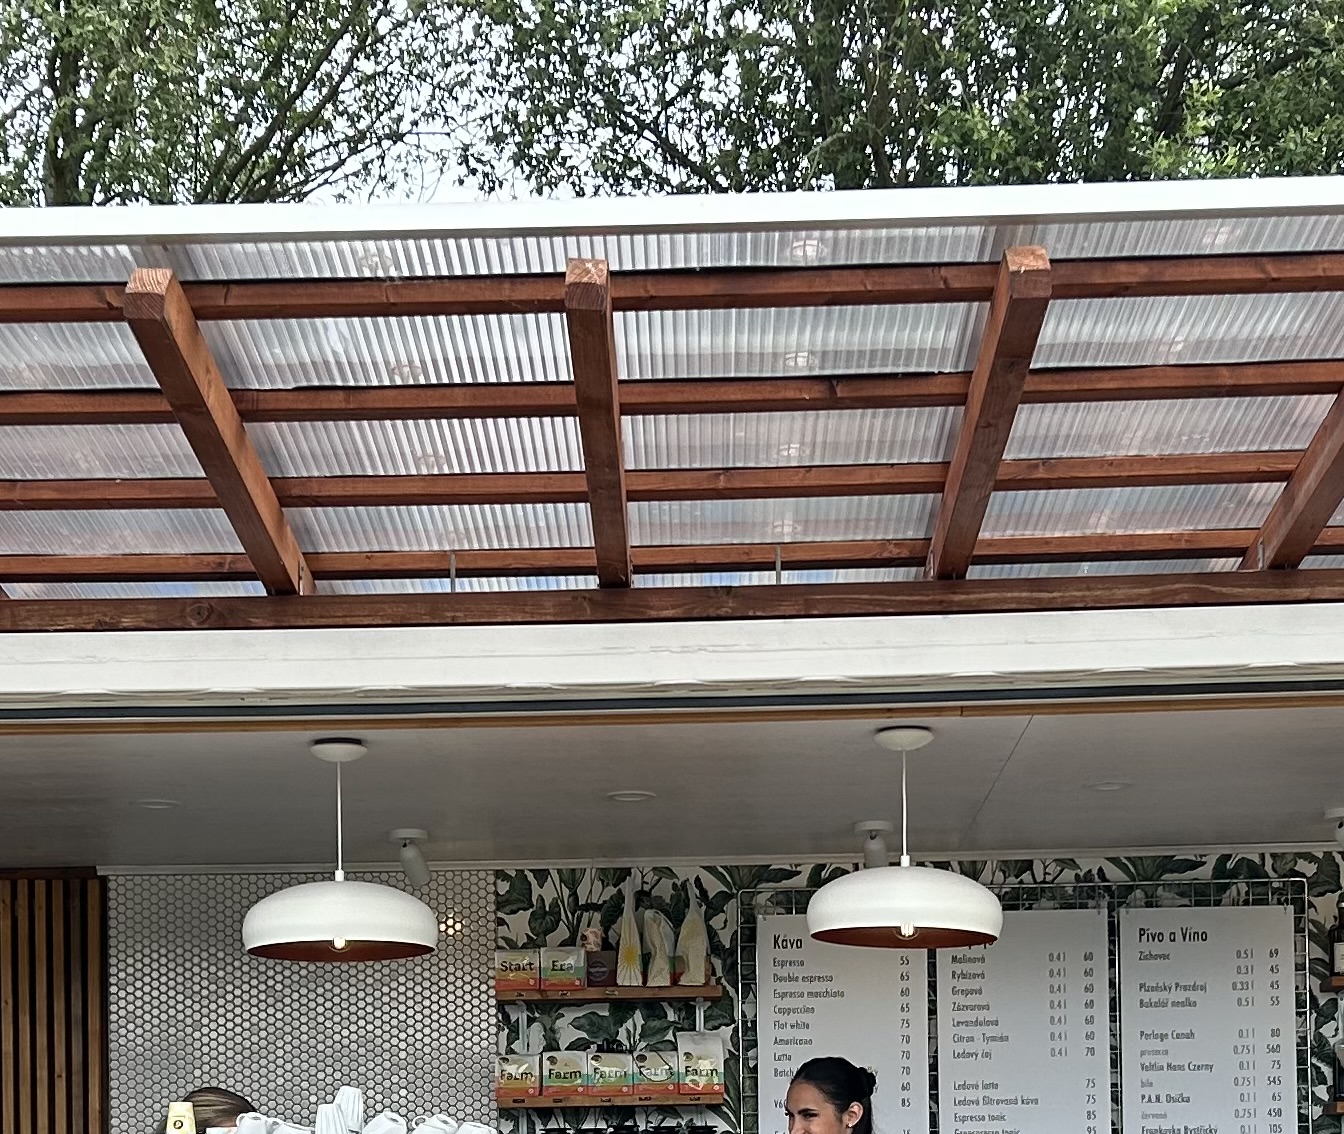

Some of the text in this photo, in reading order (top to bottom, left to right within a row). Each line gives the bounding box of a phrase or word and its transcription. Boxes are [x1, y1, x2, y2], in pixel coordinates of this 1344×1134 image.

[1169, 931, 1176, 942] a
[1181, 926, 1208, 942] Víno
[773, 934, 803, 950] Káva
[951, 954, 985, 964] Malinová
[1084, 952, 1093, 961] 60
[1269, 948, 1278, 958] 69
[500, 960, 535, 972] Start
[551, 960, 574, 972] Era
[773, 956, 910, 968] Espresso 55
[1084, 968, 1094, 977] 60
[1270, 964, 1279, 974] 45
[773, 971, 910, 984] Double espresso 65
[1084, 984, 1094, 993] 60
[1175, 981, 1207, 993] Prazdroj
[1270, 980, 1279, 990] 45
[774, 987, 910, 1000] Espresso macchiato 60
[1084, 1000, 1094, 1009] 60
[1171, 997, 1197, 1008] nealko
[1270, 996, 1280, 1006] 55
[774, 1003, 910, 1016] Cappuccino 65
[774, 1019, 910, 1030] Flat white 75
[1085, 1016, 1094, 1025] 60
[953, 1034, 974, 1043] Citron
[1085, 1032, 1095, 1040] 60
[1271, 1028, 1280, 1038] 80
[773, 1035, 910, 1046] Americano 70
[953, 1050, 978, 1061] Ledový
[1085, 1047, 1095, 1056] 70
[1266, 1044, 1280, 1054] 560
[774, 1050, 910, 1061] Latte 70
[1271, 1060, 1281, 1069] 75
[500, 1069, 534, 1081] Farm
[548, 1068, 582, 1080] Farm
[684, 1065, 719, 1078] Farm
[774, 1066, 910, 1078] Batch 70
[982, 1080, 998, 1090] latte
[1086, 1078, 1095, 1088] 75
[1267, 1076, 1281, 1085] 545
[901, 1082, 910, 1091] 60
[1086, 1095, 1096, 1104] 75
[1272, 1092, 1281, 1101] 65
[901, 1098, 911, 1107] 85
[954, 1110, 1096, 1124] Espresso tonic 85
[1267, 1108, 1282, 1117] 450
[1142, 1126, 1181, 1134] Frankovka
[1269, 1124, 1282, 1133] 105
